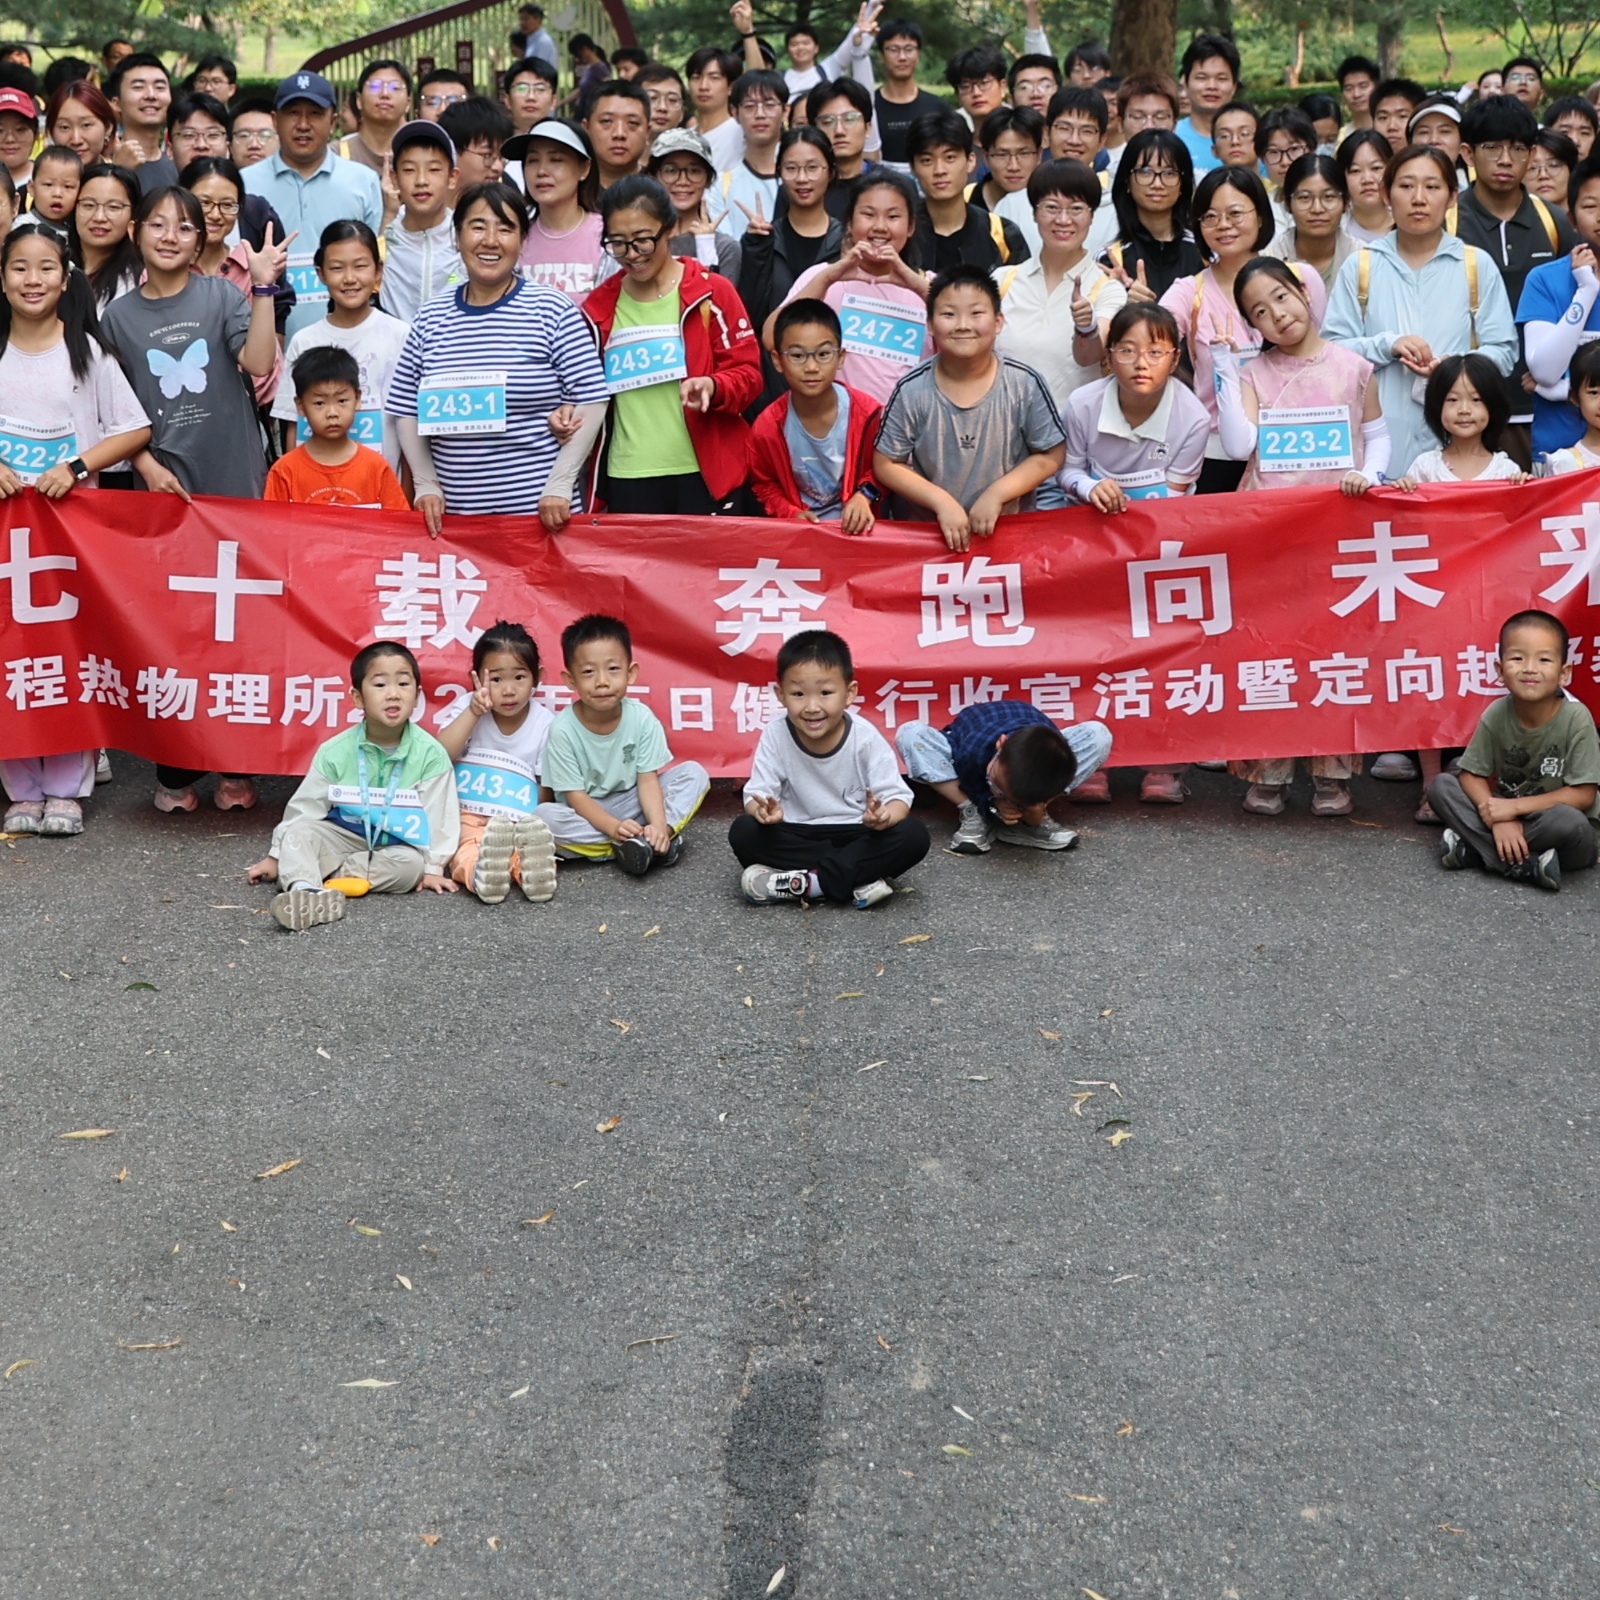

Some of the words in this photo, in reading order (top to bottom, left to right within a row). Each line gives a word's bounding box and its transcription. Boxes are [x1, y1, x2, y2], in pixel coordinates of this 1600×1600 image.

[843, 315, 918, 350] 247-2
[609, 342, 678, 377] 243-2
[426, 391, 496, 418] 243-1
[1266, 428, 1342, 455] 223-2
[457, 769, 532, 807] 243-4
